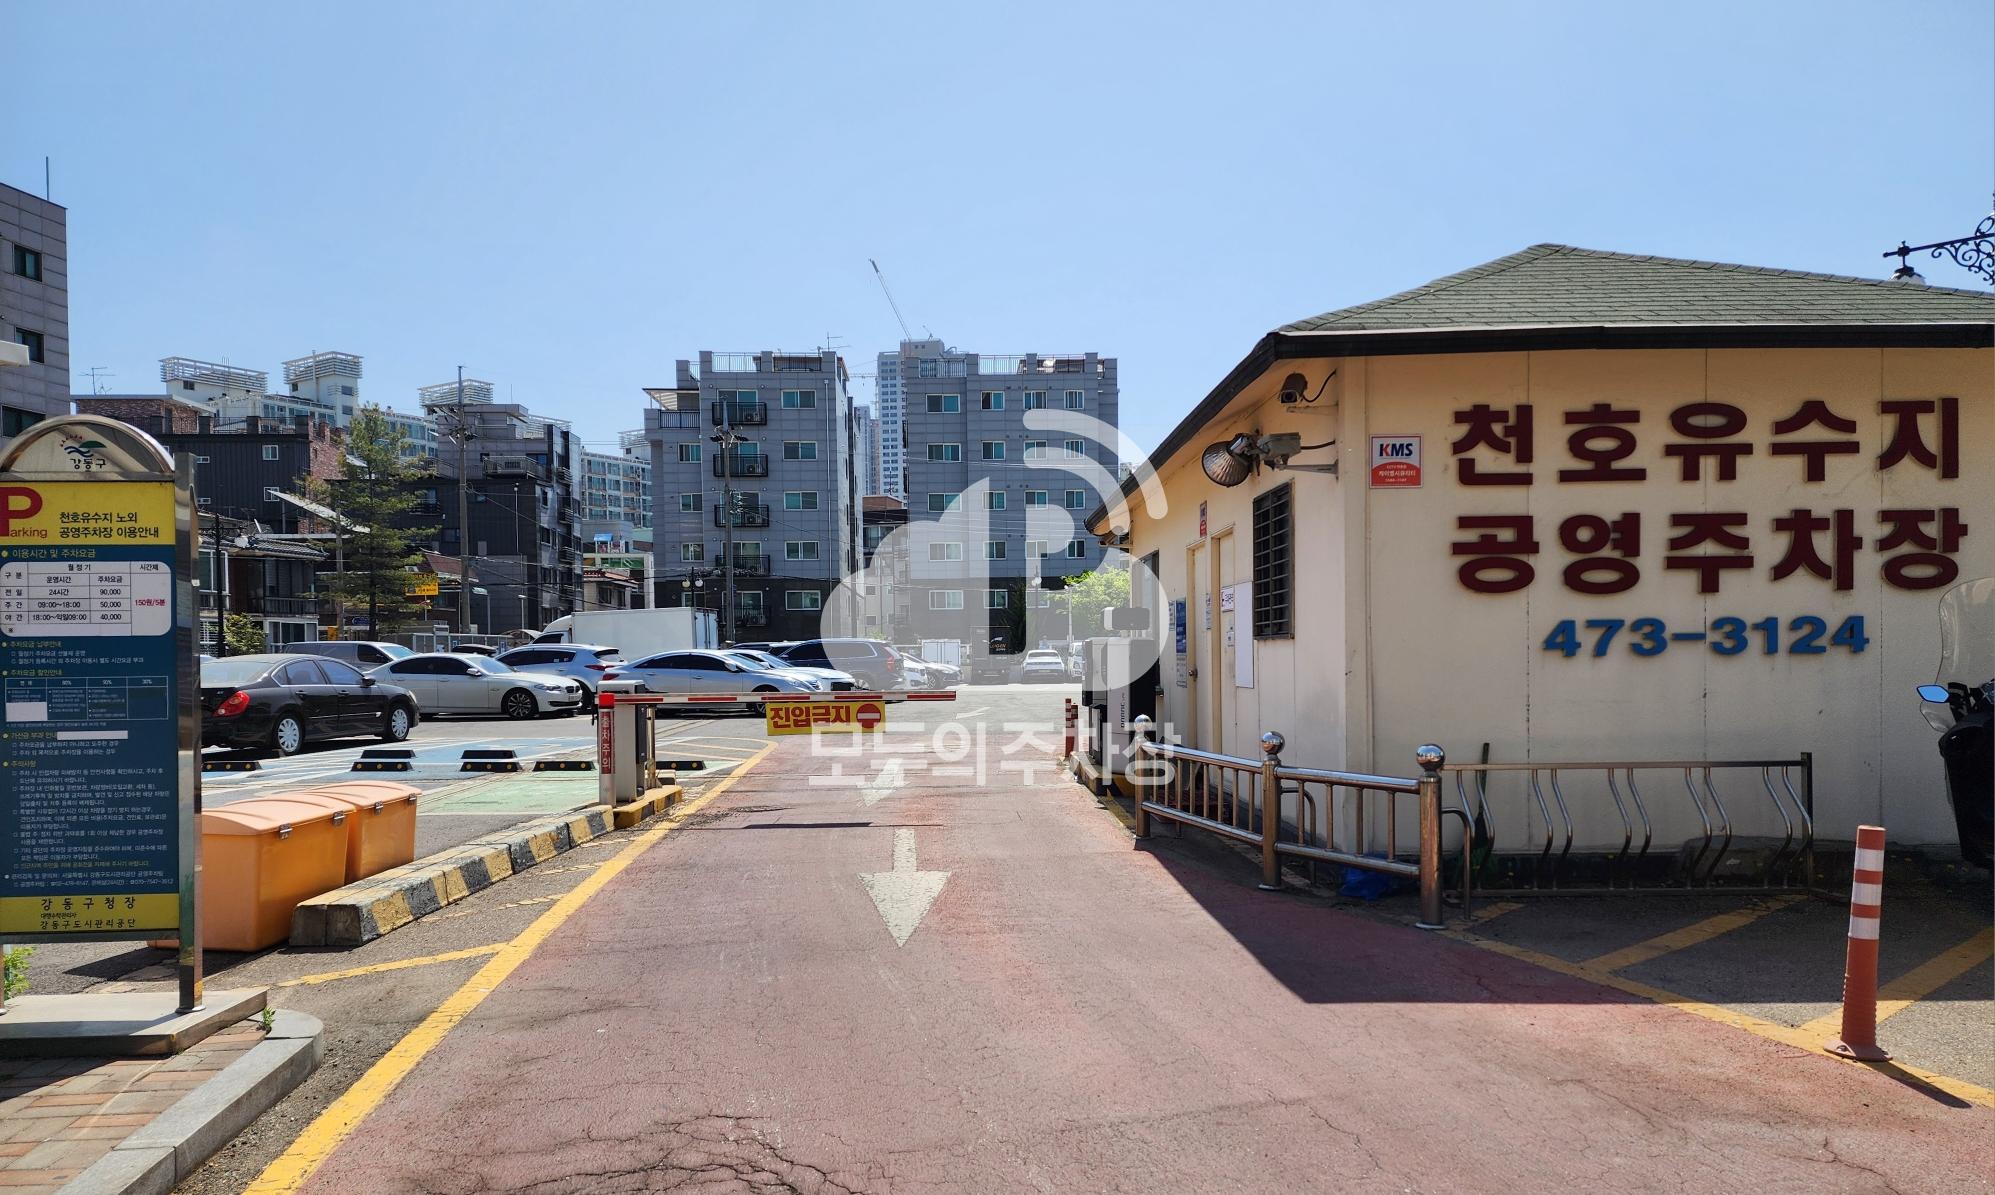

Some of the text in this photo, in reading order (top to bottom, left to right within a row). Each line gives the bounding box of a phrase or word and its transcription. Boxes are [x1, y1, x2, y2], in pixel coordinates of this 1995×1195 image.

[1452, 397, 1959, 486] 천호유수지
[1379, 443, 1413, 457] KMS
[69, 458, 107, 470] 강동구
[0, 486, 48, 538] Parking
[59, 512, 138, 524] 천호유수지 노외
[59, 526, 160, 539] 공영주차장 이용안내
[12, 548, 97, 558] 이용시간 및 주차요금
[1452, 507, 1968, 594] 공영주차장
[139, 563, 160, 571] 시간제
[46, 575, 73, 584] 운영시간
[97, 575, 123, 584] 주차요금
[48, 588, 70, 597] 24시간
[99, 588, 122, 597] 90,000
[99, 600, 122, 609] 50,000
[100, 613, 122, 622] 40,000
[1543, 615, 1871, 657] 473-3124
[770, 705, 851, 729] 진입금지
[40, 918, 136, 930] 강동구도시관리공단
